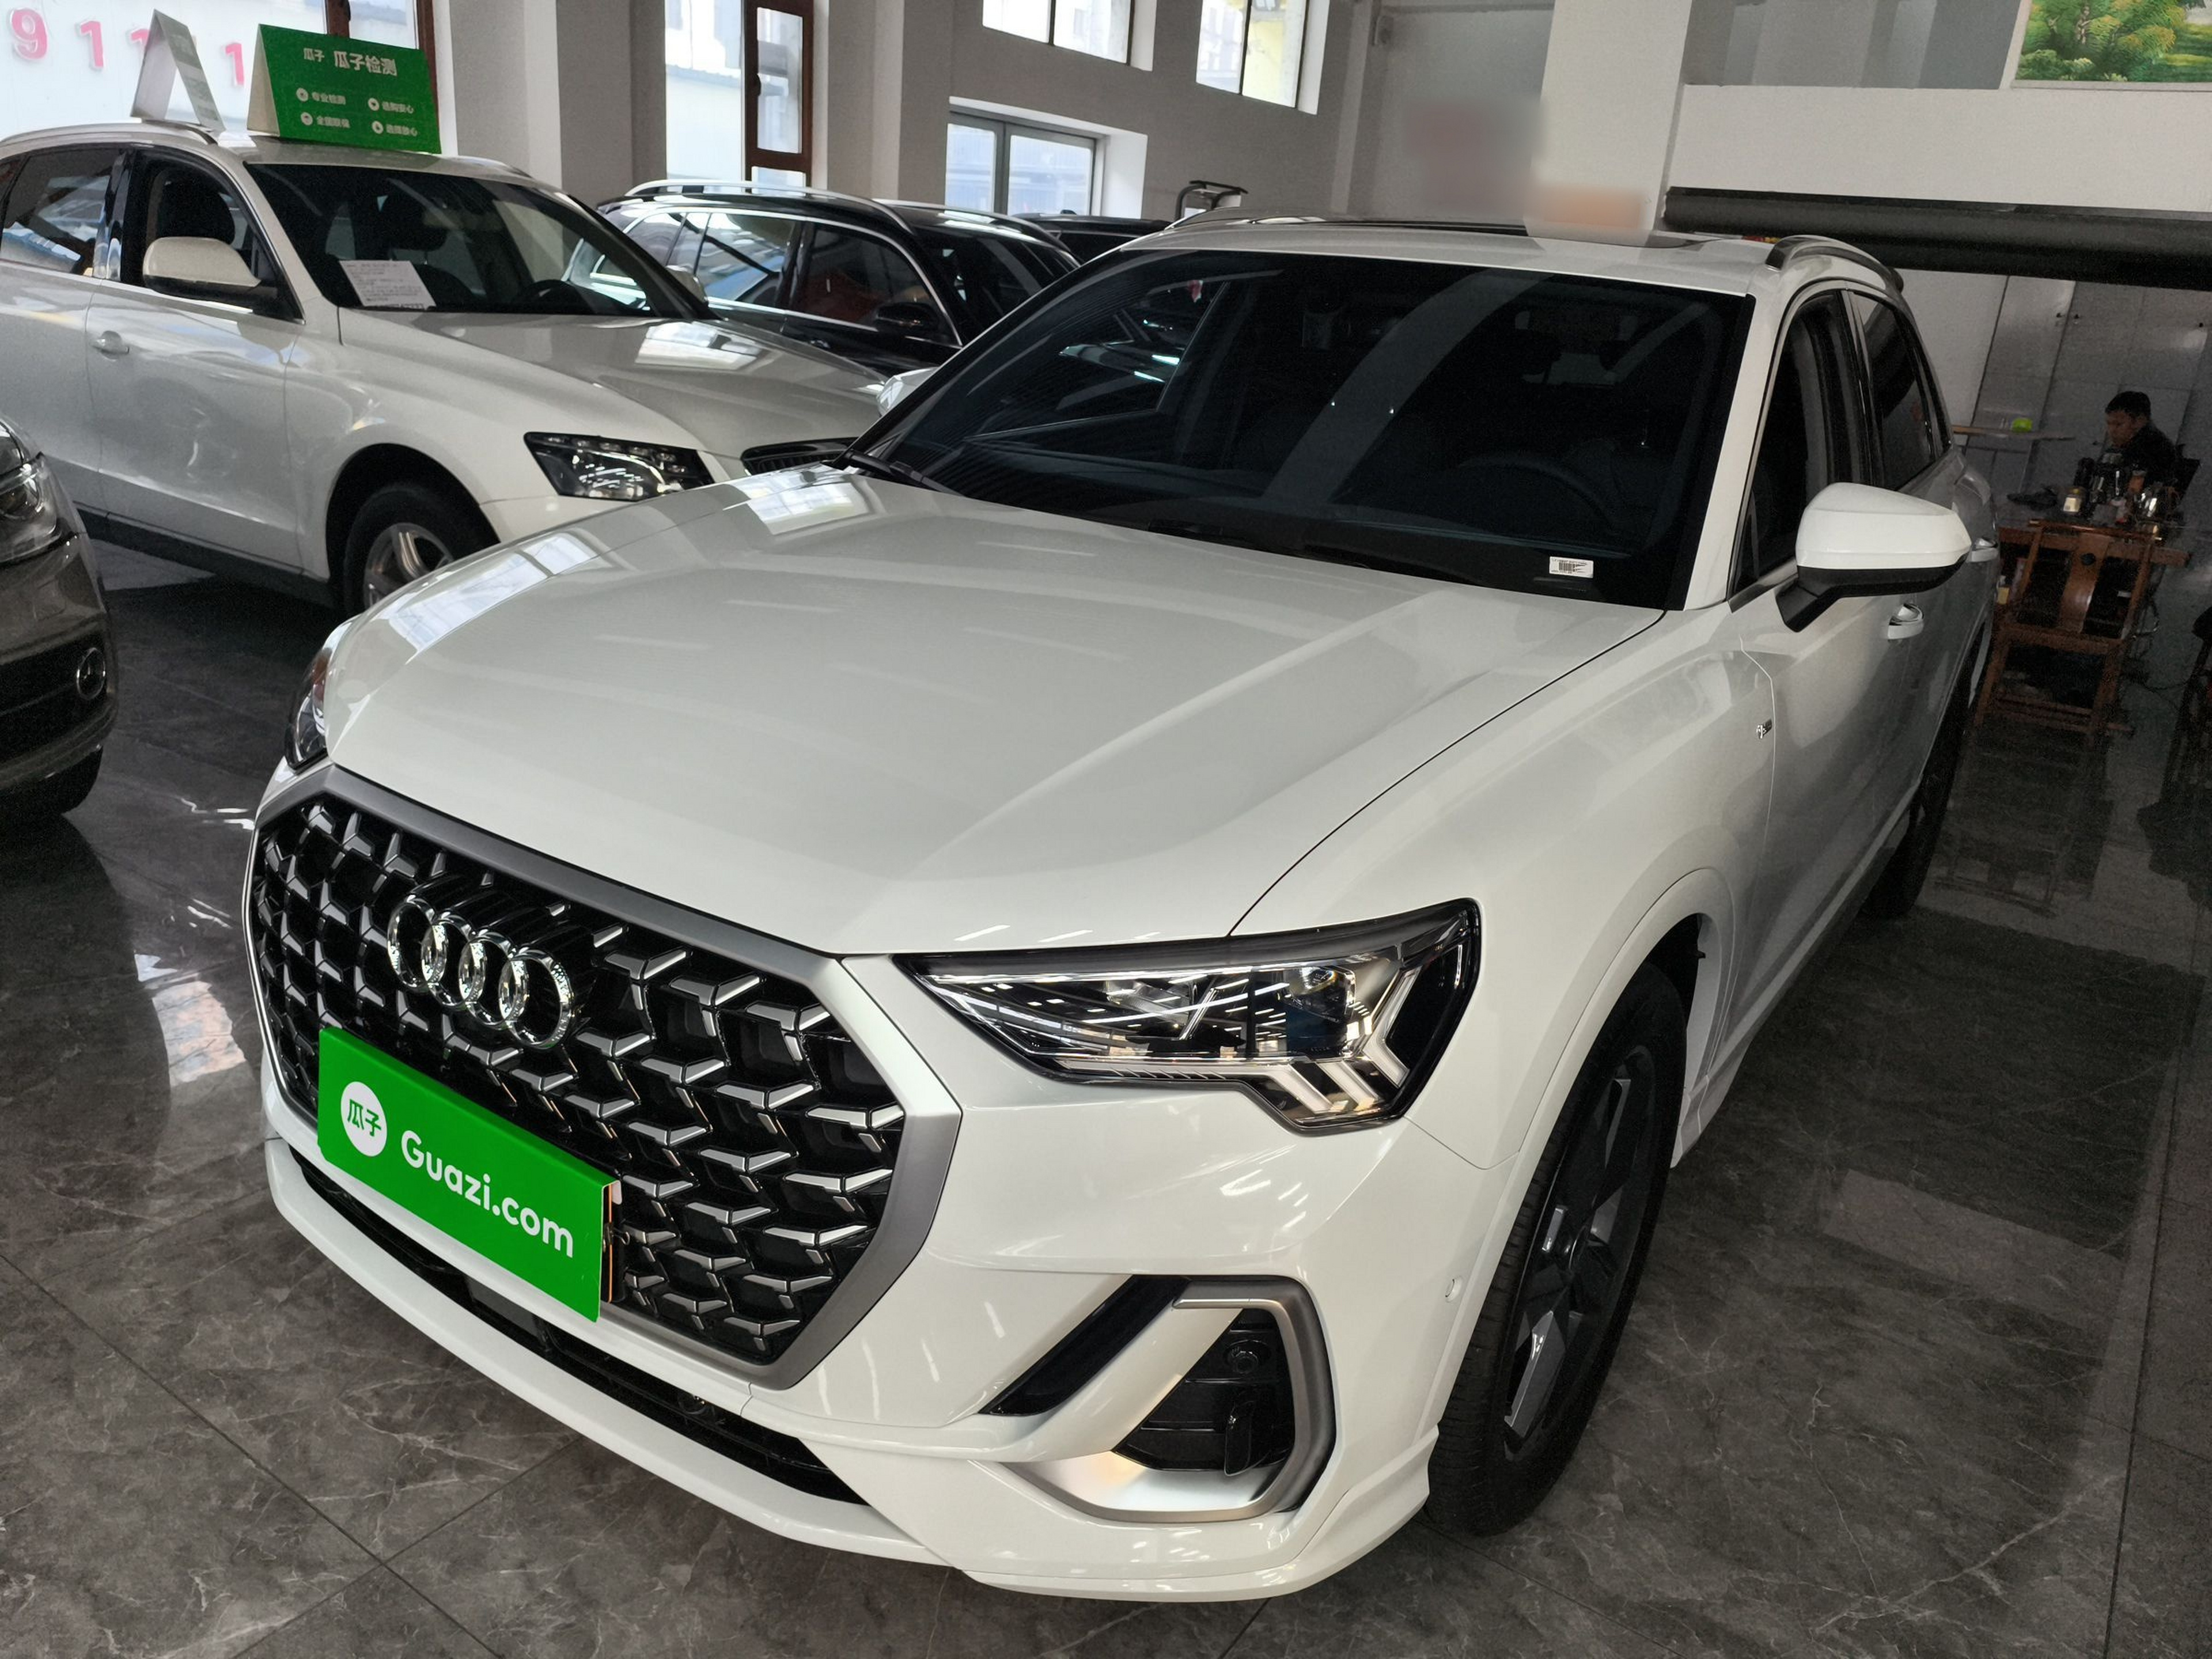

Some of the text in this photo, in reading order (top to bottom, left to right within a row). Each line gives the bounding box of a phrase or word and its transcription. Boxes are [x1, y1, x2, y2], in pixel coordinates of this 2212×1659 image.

[334, 51, 397, 76] 瓜子检测
[347, 1099, 573, 1258] 瓜子 Guazi.com
